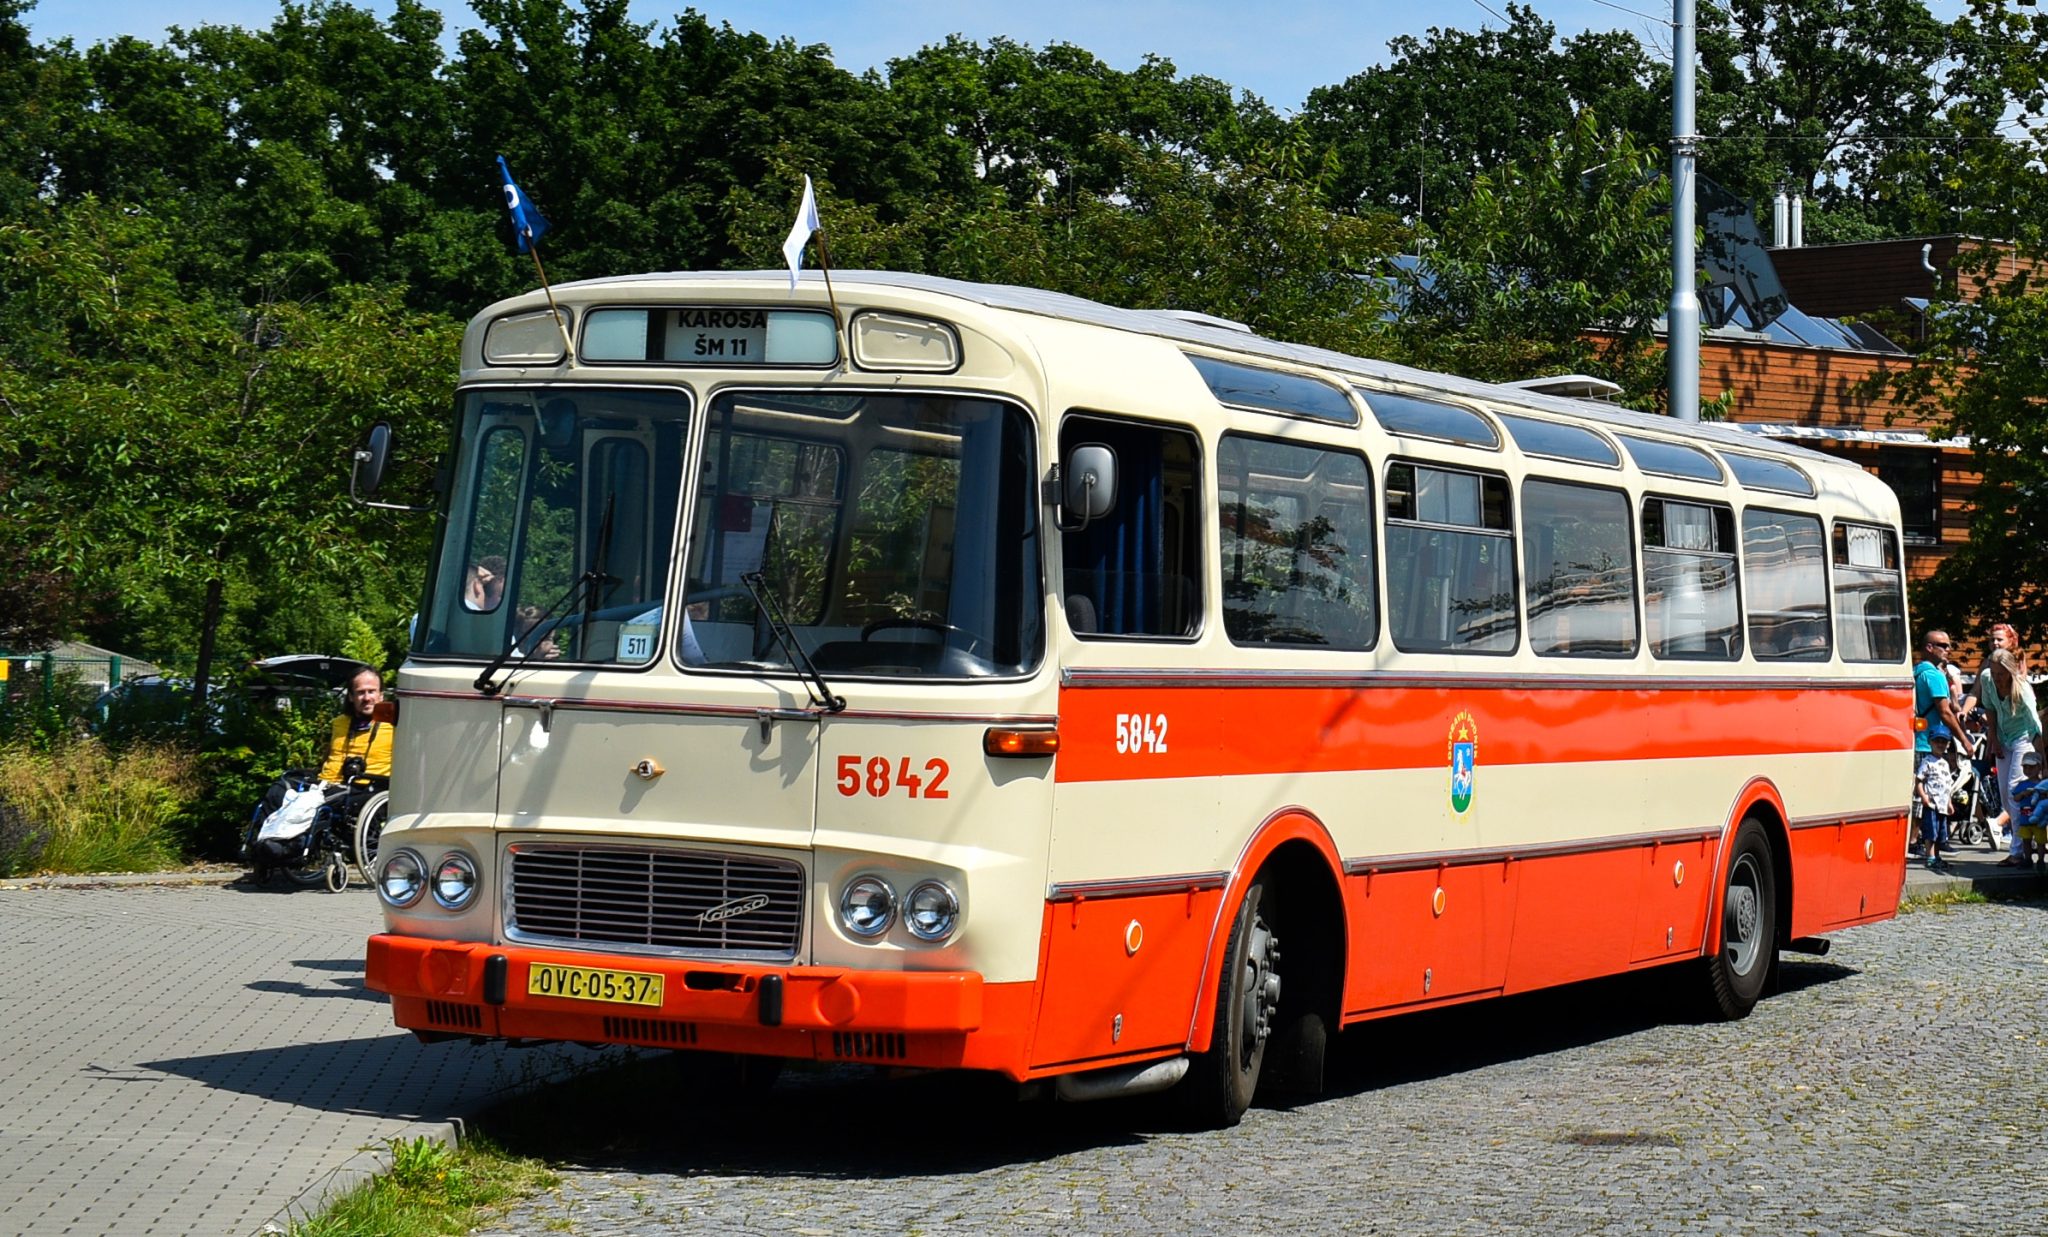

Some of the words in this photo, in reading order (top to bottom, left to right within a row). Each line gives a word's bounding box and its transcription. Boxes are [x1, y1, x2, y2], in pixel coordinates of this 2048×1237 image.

[678, 310, 767, 329] KAROSA
[694, 333, 725, 355] ŠM
[730, 338, 747, 355] 11
[627, 637, 647, 655] 511
[1116, 713, 1168, 754] 5842
[837, 755, 949, 799] 5842
[695, 894, 770, 931] Karosa
